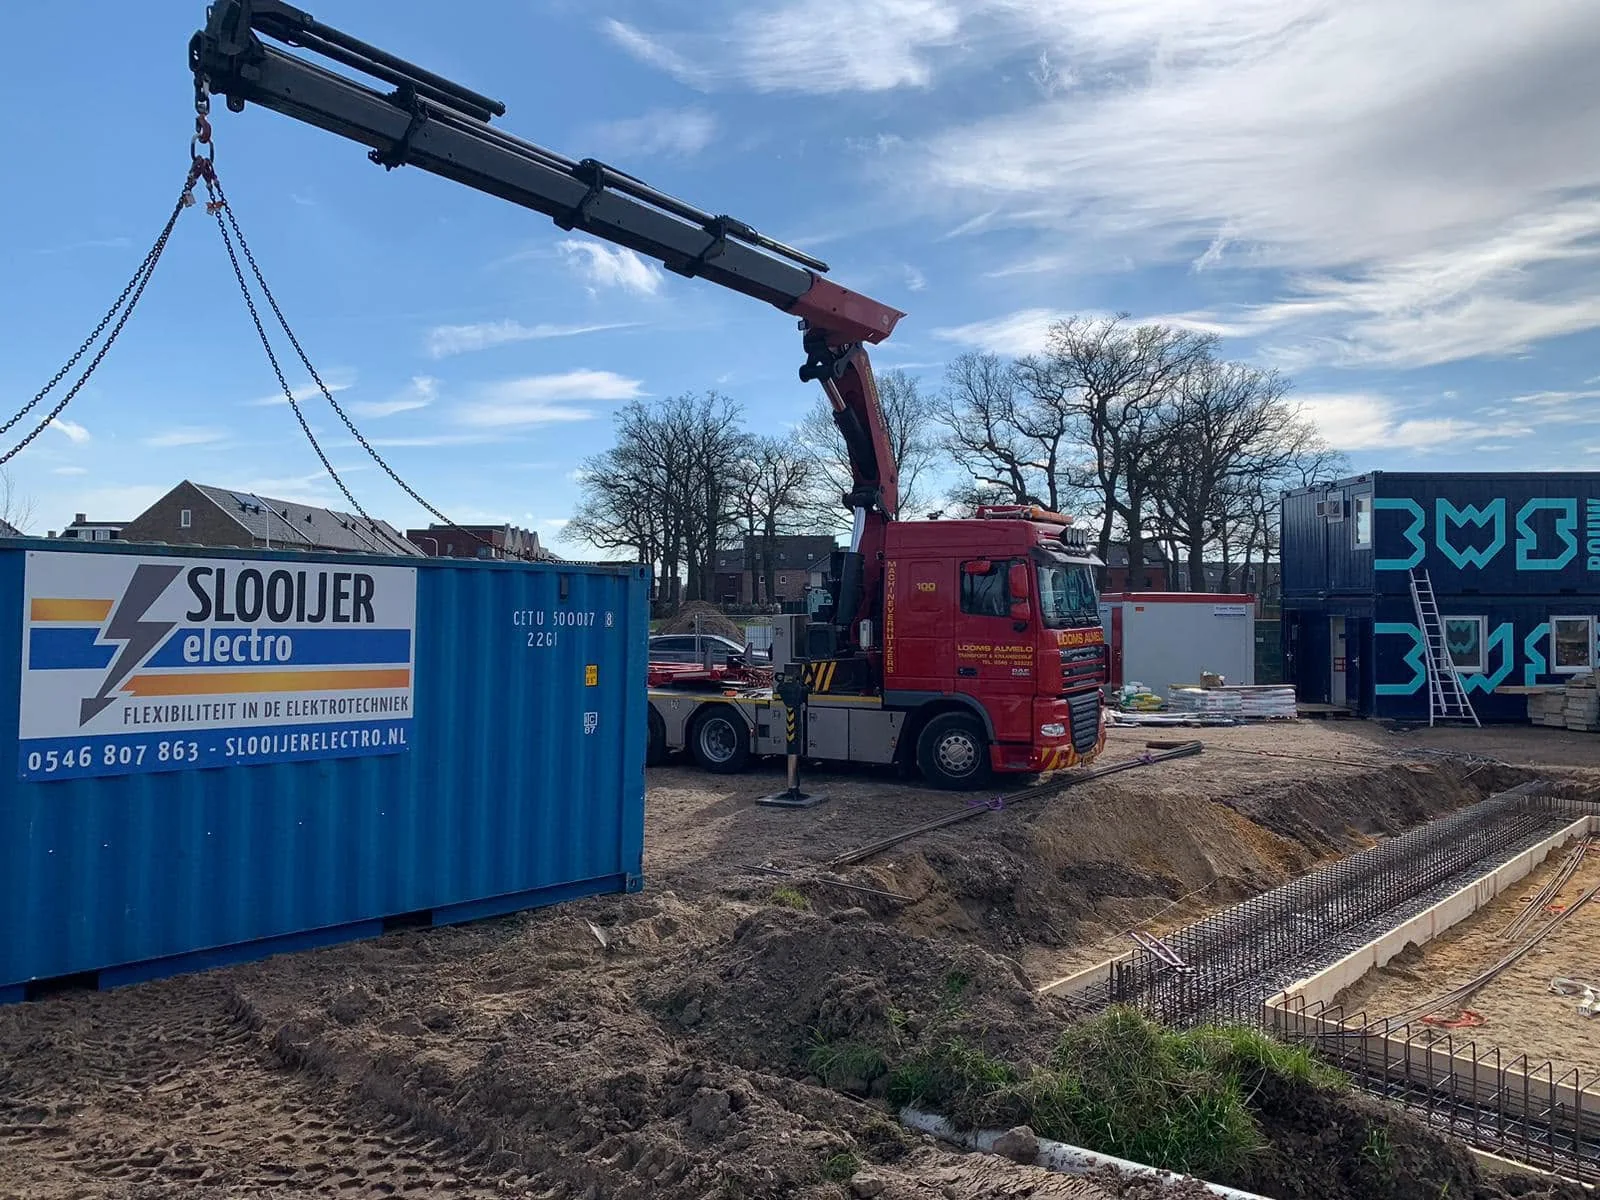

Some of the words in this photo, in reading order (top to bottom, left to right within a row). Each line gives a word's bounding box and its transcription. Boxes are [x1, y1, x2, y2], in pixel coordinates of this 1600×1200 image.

[186, 566, 375, 624] SLOOIJER
[513, 610, 544, 626] CETU
[887, 561, 897, 673] MACHINEVERHUIZERS
[183, 627, 292, 663] electro
[957, 644, 991, 652] LOOMS
[994, 645, 1033, 653] ALMELO
[1057, 631, 1083, 646] LOOMS
[124, 702, 237, 725] FLEXIBILITEIT
[242, 702, 259, 719] IN
[264, 700, 281, 718] DE
[286, 696, 409, 718] ELEKTROTECHNIEK
[28, 745, 92, 773] 0546
[103, 743, 147, 767] 807
[158, 740, 199, 763] 863
[225, 727, 407, 757] SLOOIJERELECTRO.NL
